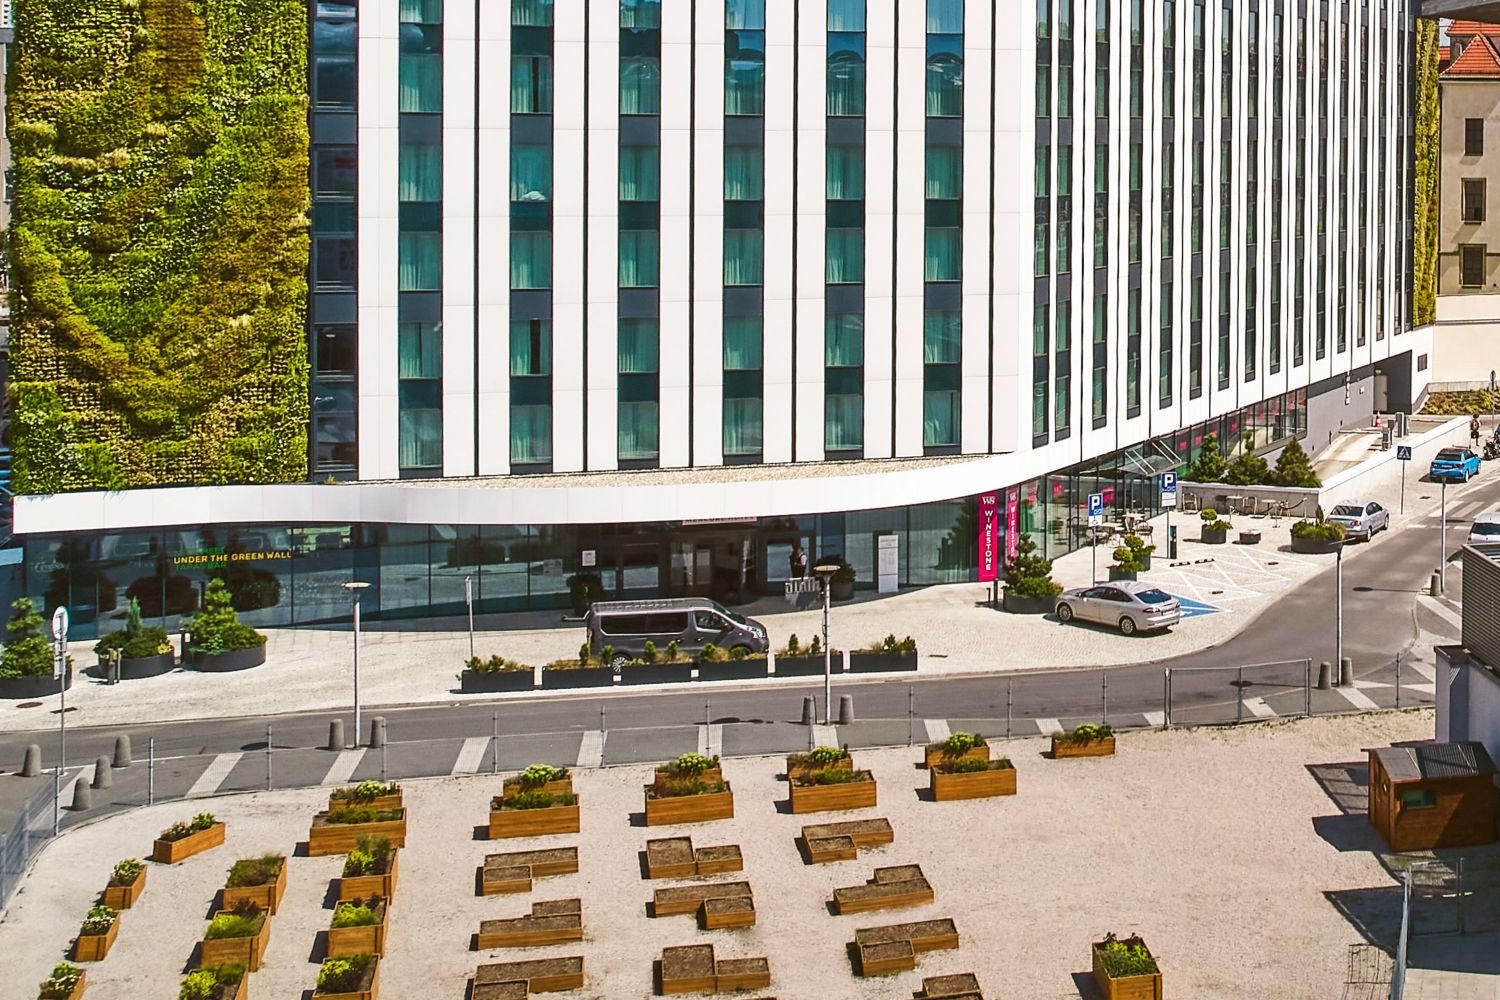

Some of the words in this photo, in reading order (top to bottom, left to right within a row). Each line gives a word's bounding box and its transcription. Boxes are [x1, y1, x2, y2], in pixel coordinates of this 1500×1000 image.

[1164, 474, 1174, 488] P
[1091, 496, 1101, 510] P
[984, 509, 994, 571] WINESTONE
[173, 555, 208, 564] UNDER
[210, 554, 229, 562] THE
[231, 552, 265, 561] GREEN
[266, 551, 292, 559] WALL
